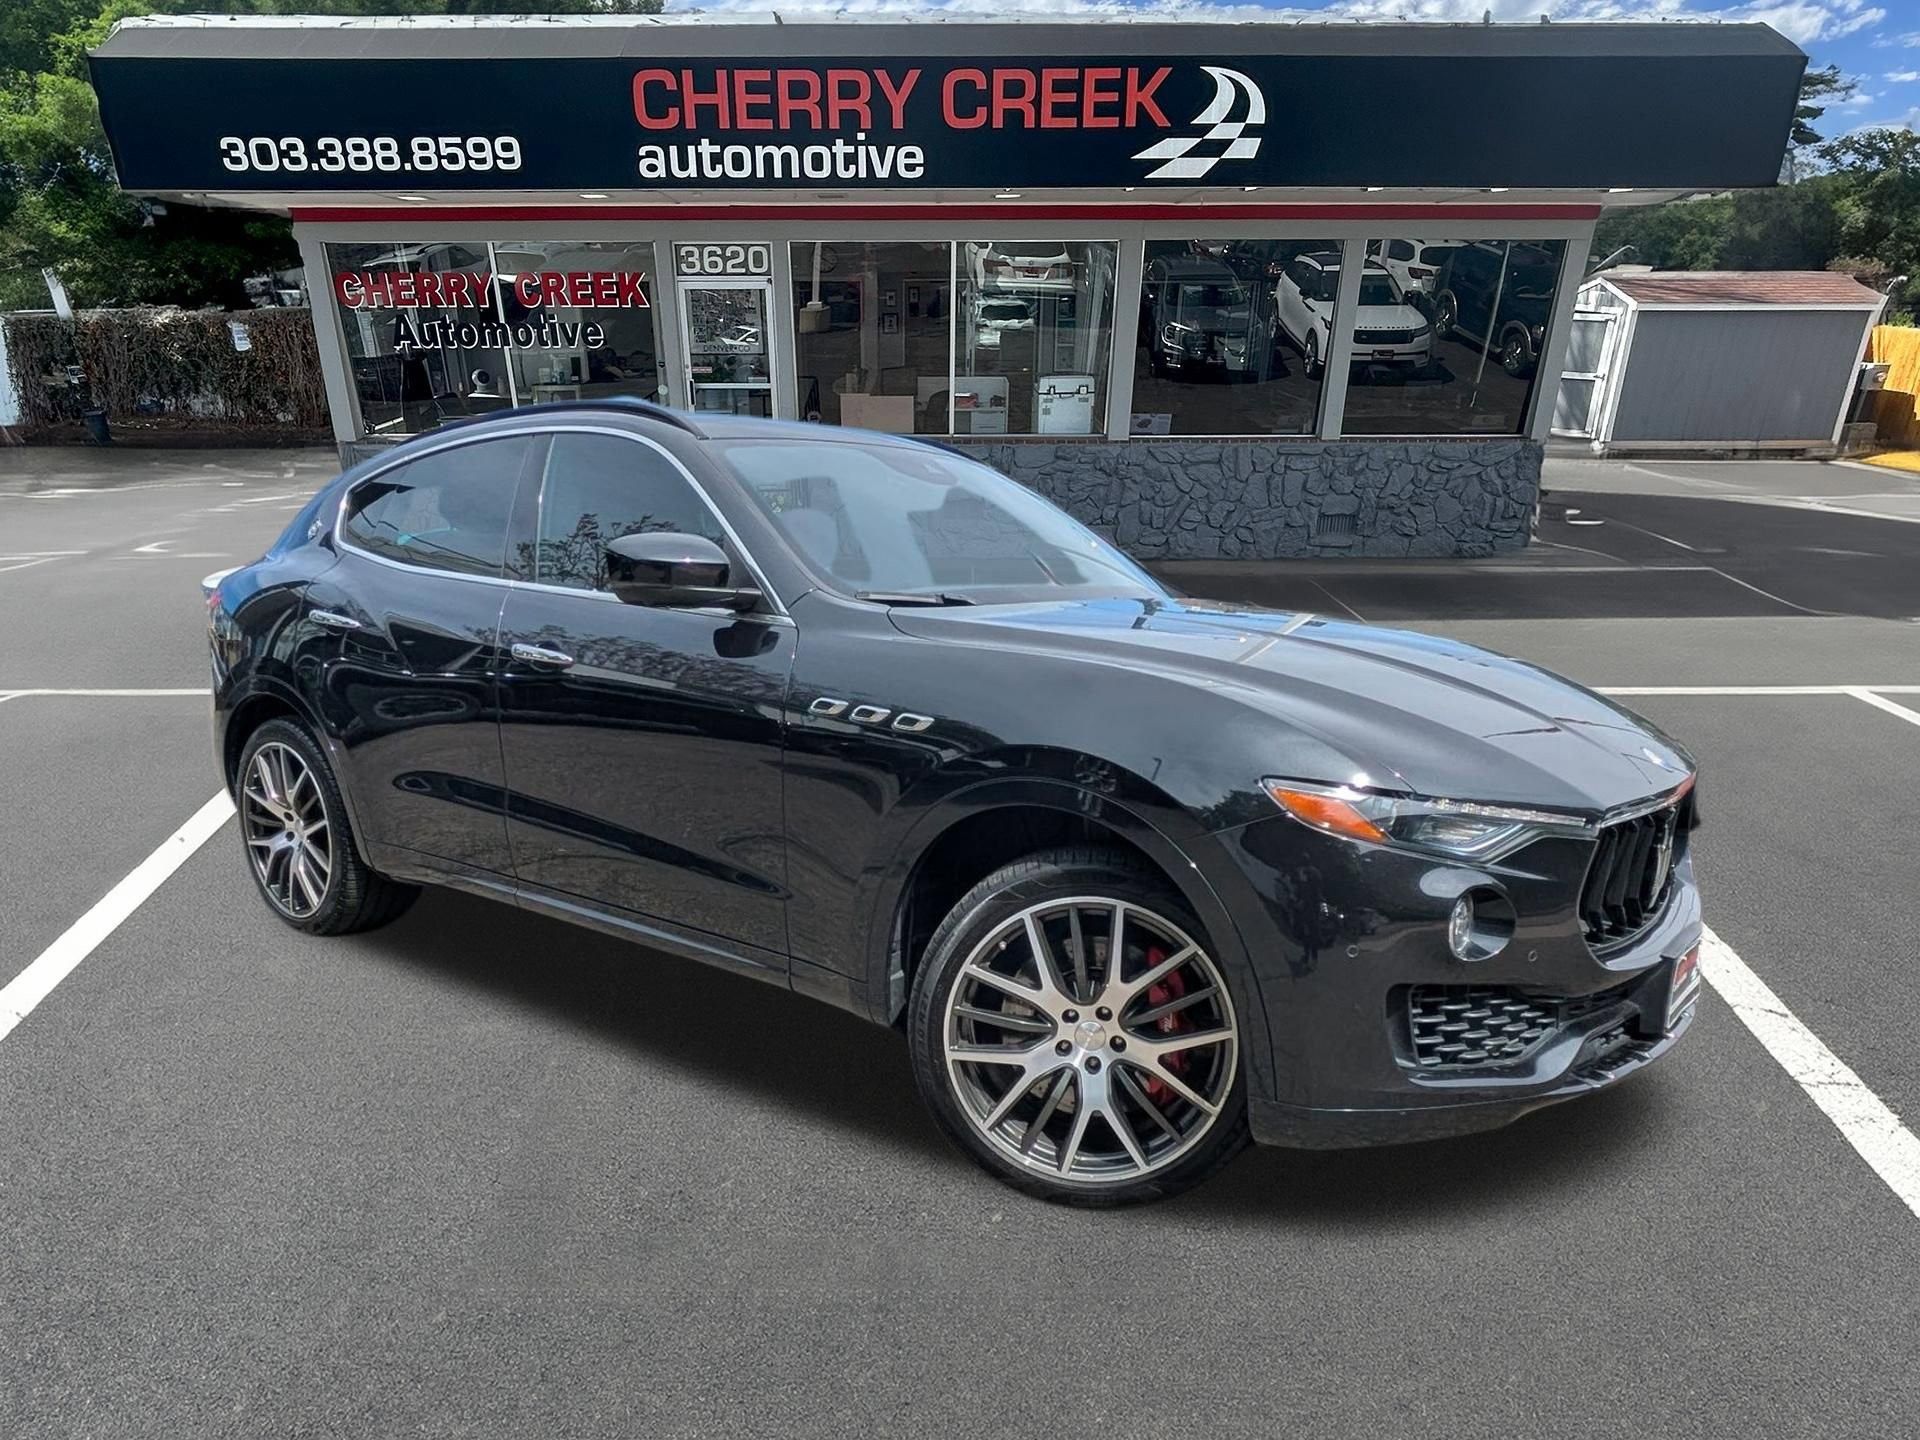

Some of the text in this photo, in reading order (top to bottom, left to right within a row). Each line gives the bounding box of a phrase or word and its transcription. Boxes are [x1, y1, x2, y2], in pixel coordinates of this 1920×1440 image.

[632, 67, 1174, 130] CHERRY CREEK
[219, 136, 522, 172] 303.388.8599
[638, 132, 924, 179] automotive
[680, 245, 769, 274] 3620
[334, 271, 651, 309] CHERRY CREEK
[393, 313, 606, 350] Automotive
